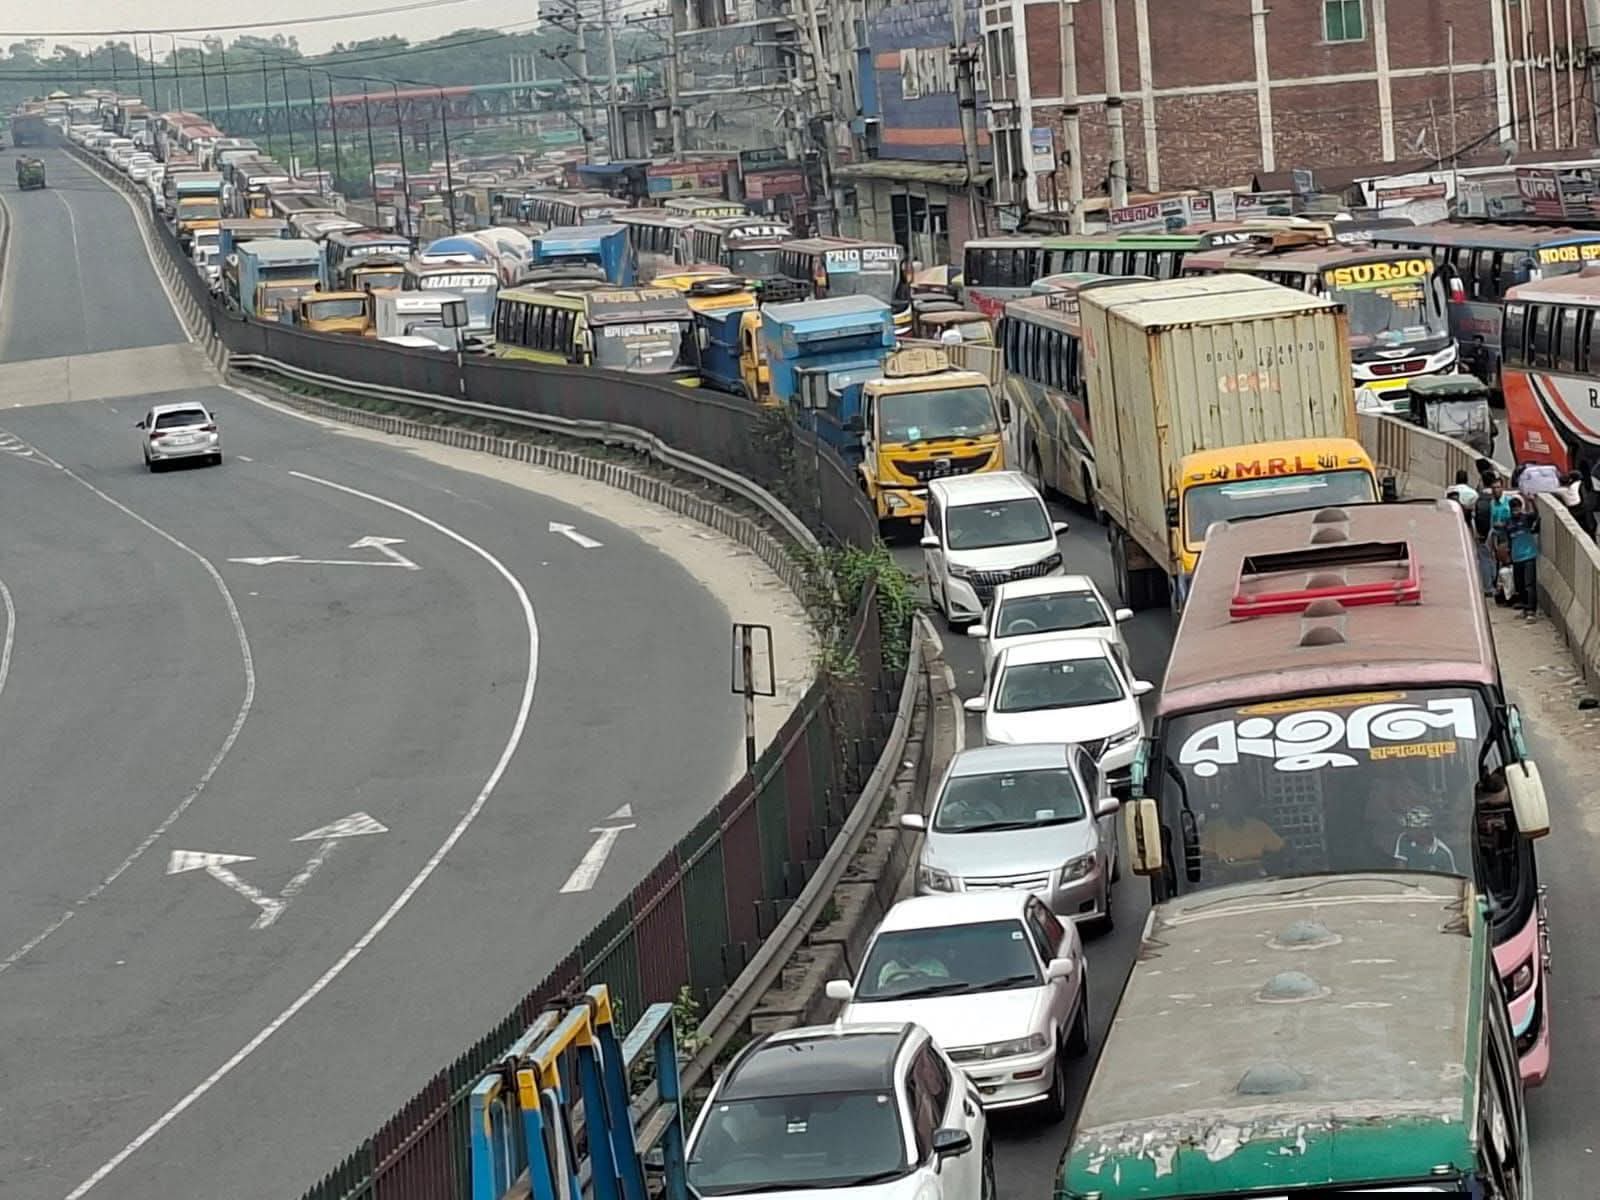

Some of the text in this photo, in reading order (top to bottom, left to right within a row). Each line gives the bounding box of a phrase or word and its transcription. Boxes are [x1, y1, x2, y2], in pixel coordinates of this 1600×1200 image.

[825, 249, 859, 262] PRIO
[1539, 246, 1580, 264] NOOR
[1334, 259, 1426, 286] SURJO
[1179, 697, 1478, 777] রংতুলি
